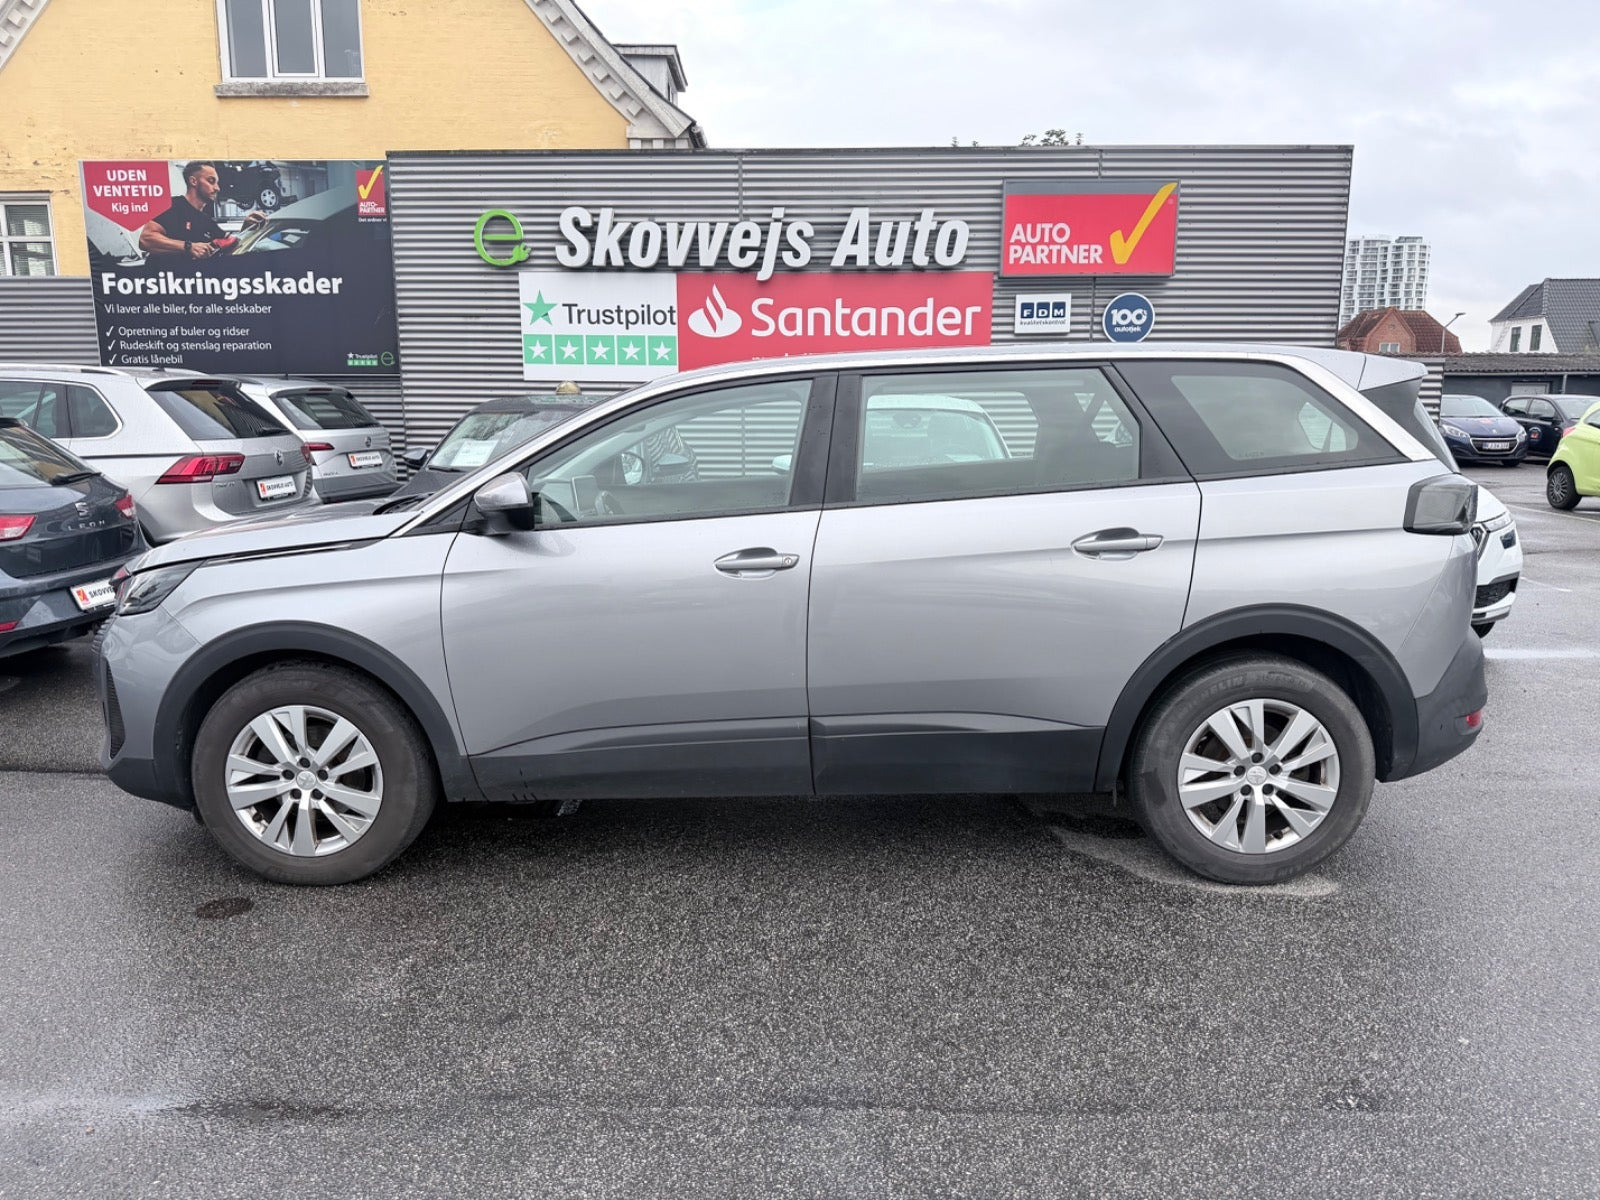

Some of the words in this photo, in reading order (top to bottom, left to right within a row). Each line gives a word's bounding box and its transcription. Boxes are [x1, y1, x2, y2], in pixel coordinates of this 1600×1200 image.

[106, 169, 147, 182] UDEN
[92, 185, 164, 197] VENTETID
[111, 202, 130, 215] Kig
[131, 202, 149, 213] ind
[1009, 223, 1071, 243] AUTO
[555, 206, 815, 282] Skovvejs
[830, 207, 970, 268] Auto
[1008, 244, 1104, 265] PARTNER
[101, 271, 343, 300] Forsikringsskader
[104, 304, 115, 314] Vi
[117, 304, 141, 314] laver
[143, 304, 161, 314] alle
[162, 304, 187, 315] biler,
[189, 303, 203, 314] for
[205, 303, 223, 314] alle
[225, 303, 272, 314] selskaber
[1022, 306, 1065, 318] FDM
[562, 303, 677, 330] Trustpilot
[751, 297, 982, 337] Santander
[118, 326, 168, 338] Opretning
[169, 326, 180, 336] af
[181, 326, 206, 336] buler
[208, 328, 221, 338] og
[222, 326, 250, 336] ridser
[120, 340, 165, 350] Rudeskift
[166, 342, 179, 352] og
[181, 341, 221, 352] stenslag
[222, 341, 272, 352] reparation
[121, 354, 149, 364] Gratis
[150, 354, 183, 364] lånebil
